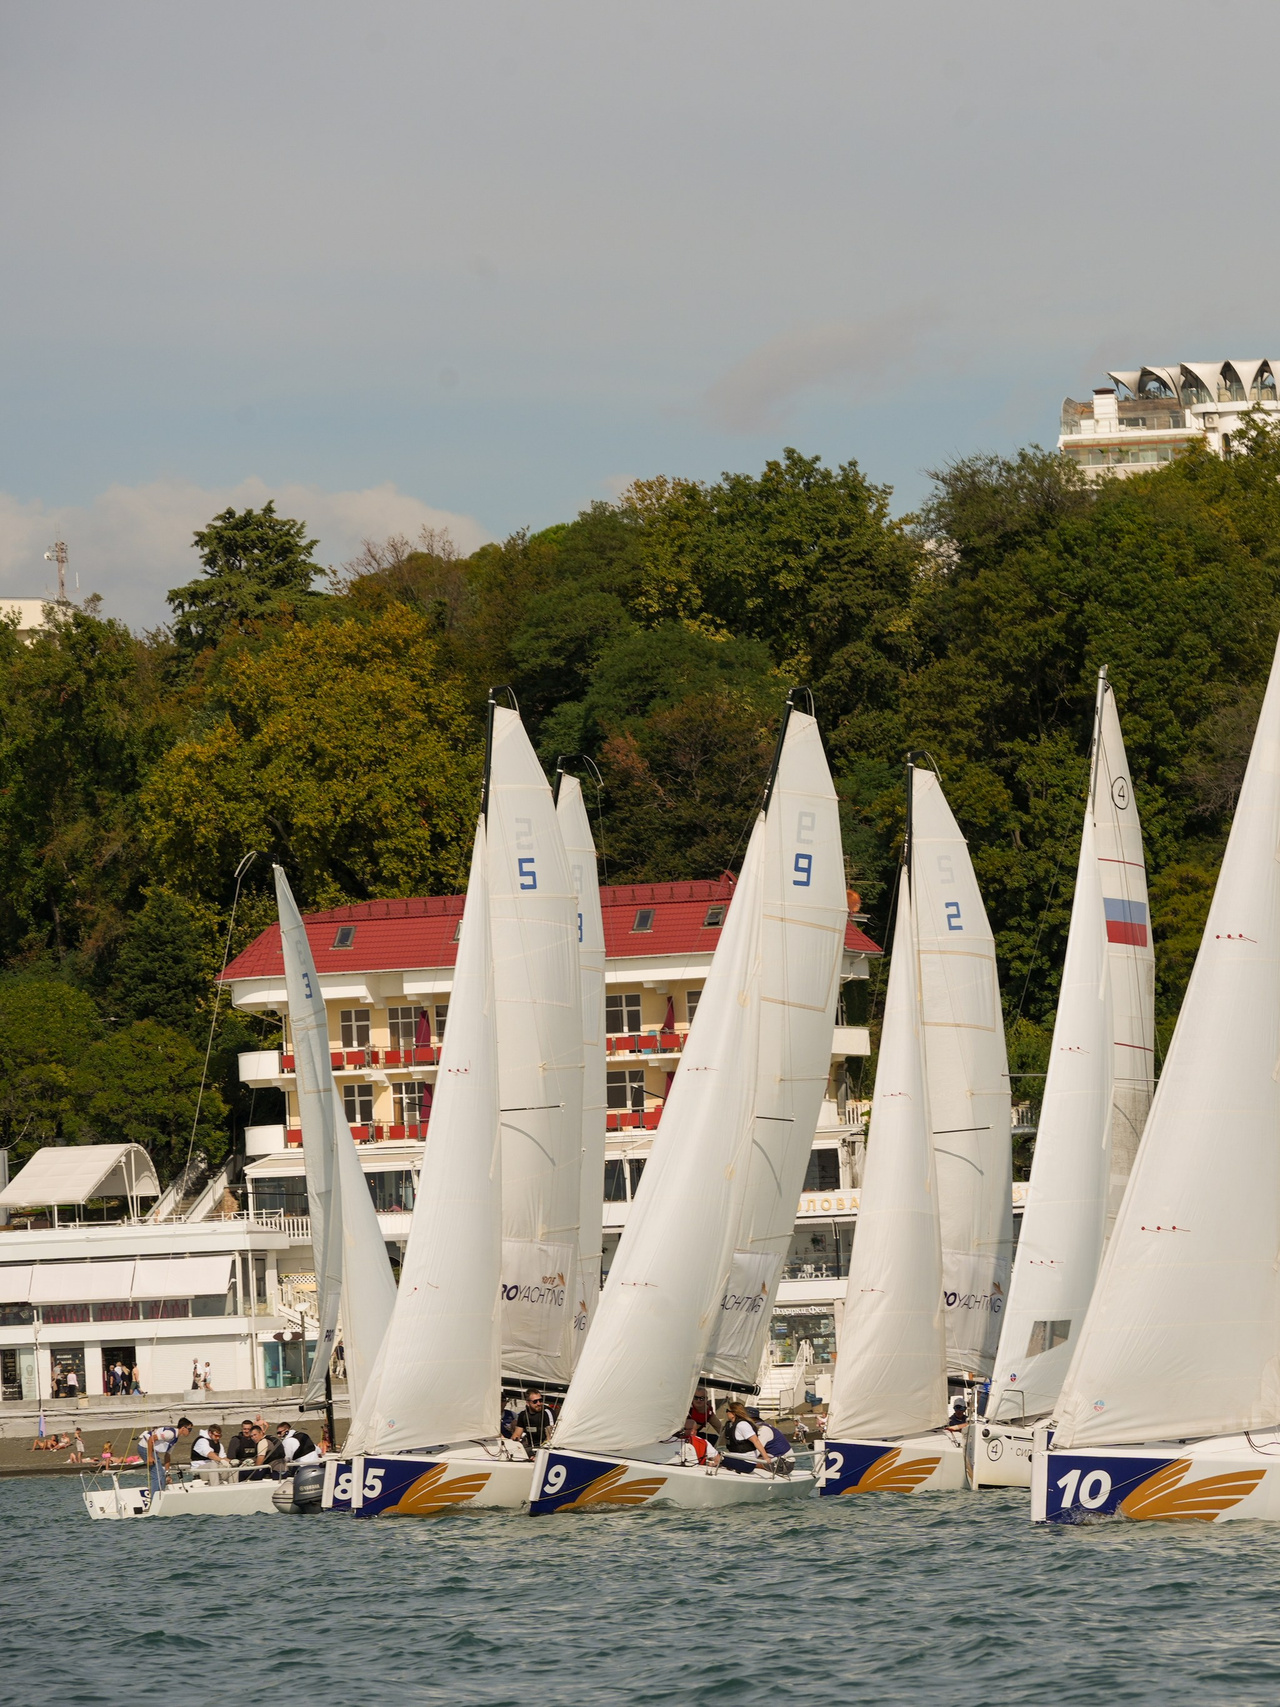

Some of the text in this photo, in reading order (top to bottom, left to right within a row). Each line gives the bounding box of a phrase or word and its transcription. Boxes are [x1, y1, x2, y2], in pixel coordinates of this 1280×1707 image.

[517, 857, 537, 890] 5
[792, 852, 813, 887] 9
[944, 901, 964, 931] 2
[302, 972, 313, 999] 3
[543, 1464, 567, 1494] 9
[823, 1451, 844, 1480] 2
[333, 1472, 353, 1500] 8
[362, 1467, 386, 1499] 5
[1056, 1469, 1112, 1509] 10
